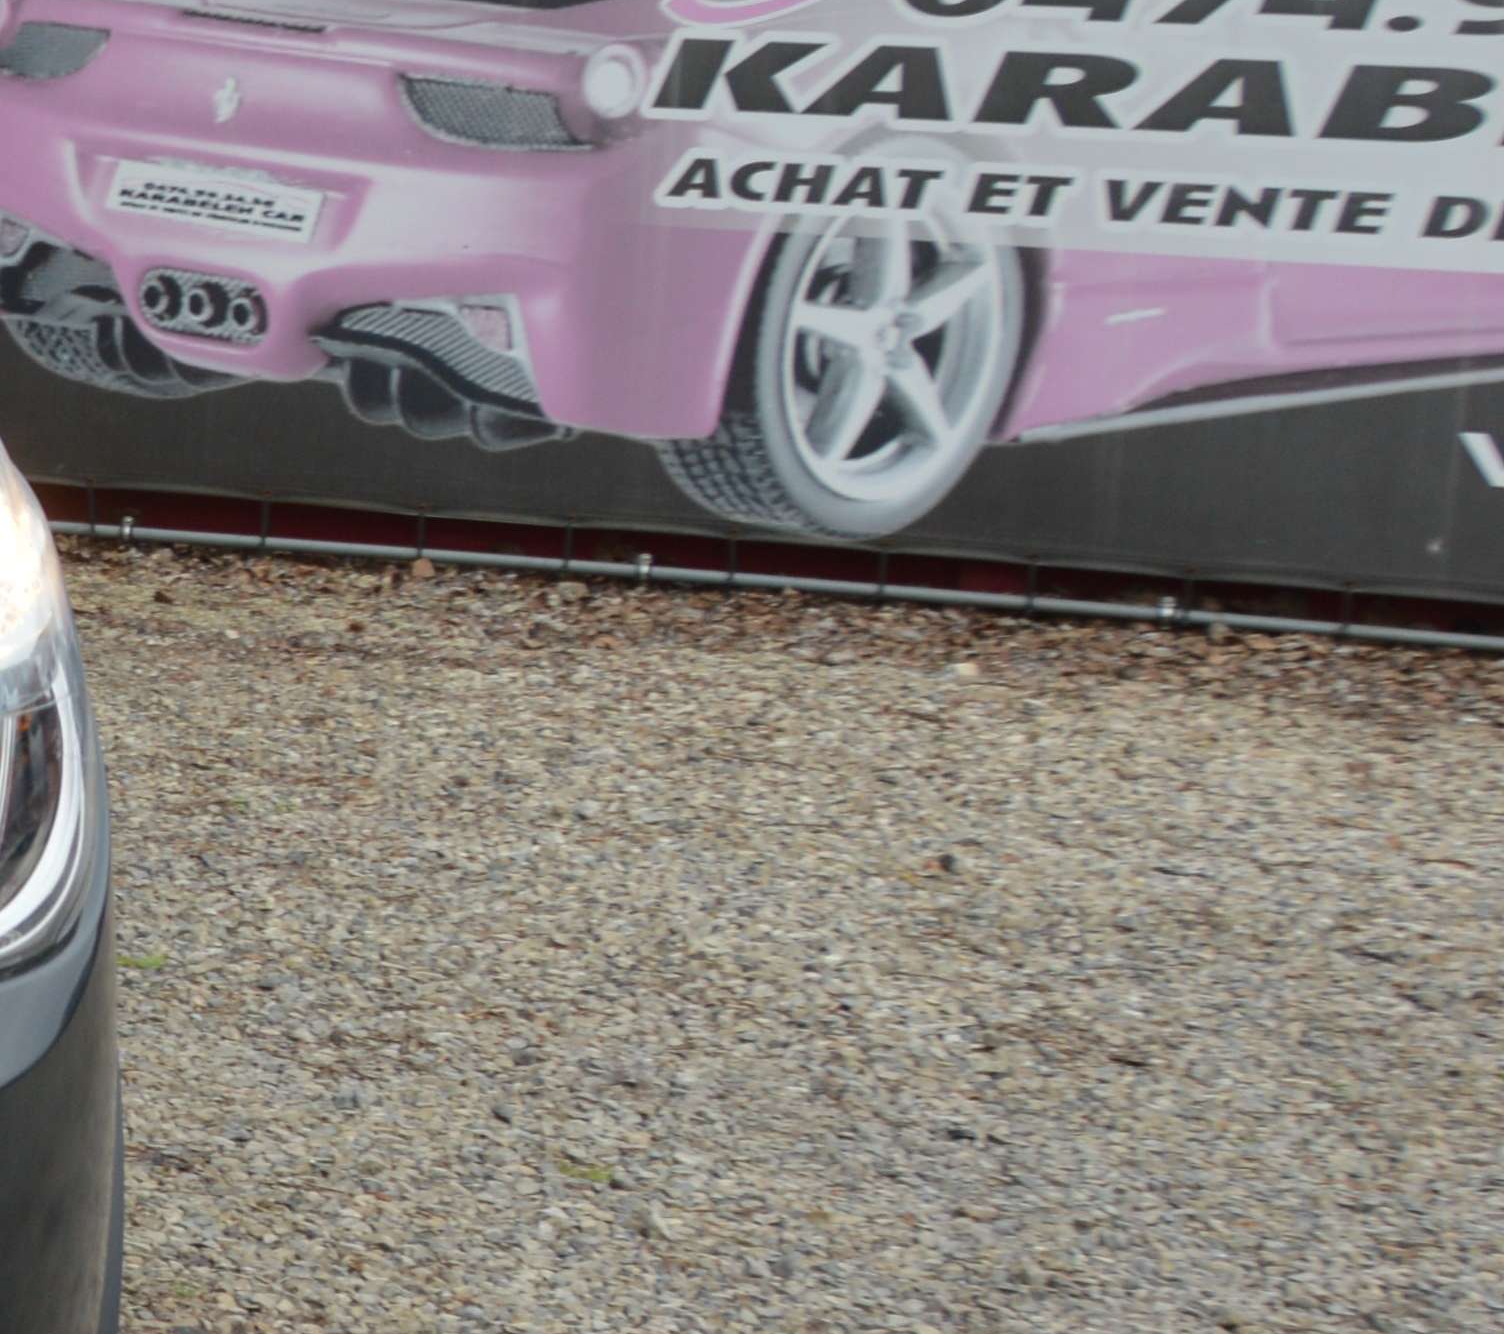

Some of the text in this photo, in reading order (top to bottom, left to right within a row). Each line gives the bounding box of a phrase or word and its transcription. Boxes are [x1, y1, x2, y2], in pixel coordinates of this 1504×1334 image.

[651, 37, 1504, 146] KARAB
[667, 157, 1504, 243] ACHAT ET VENTE D
